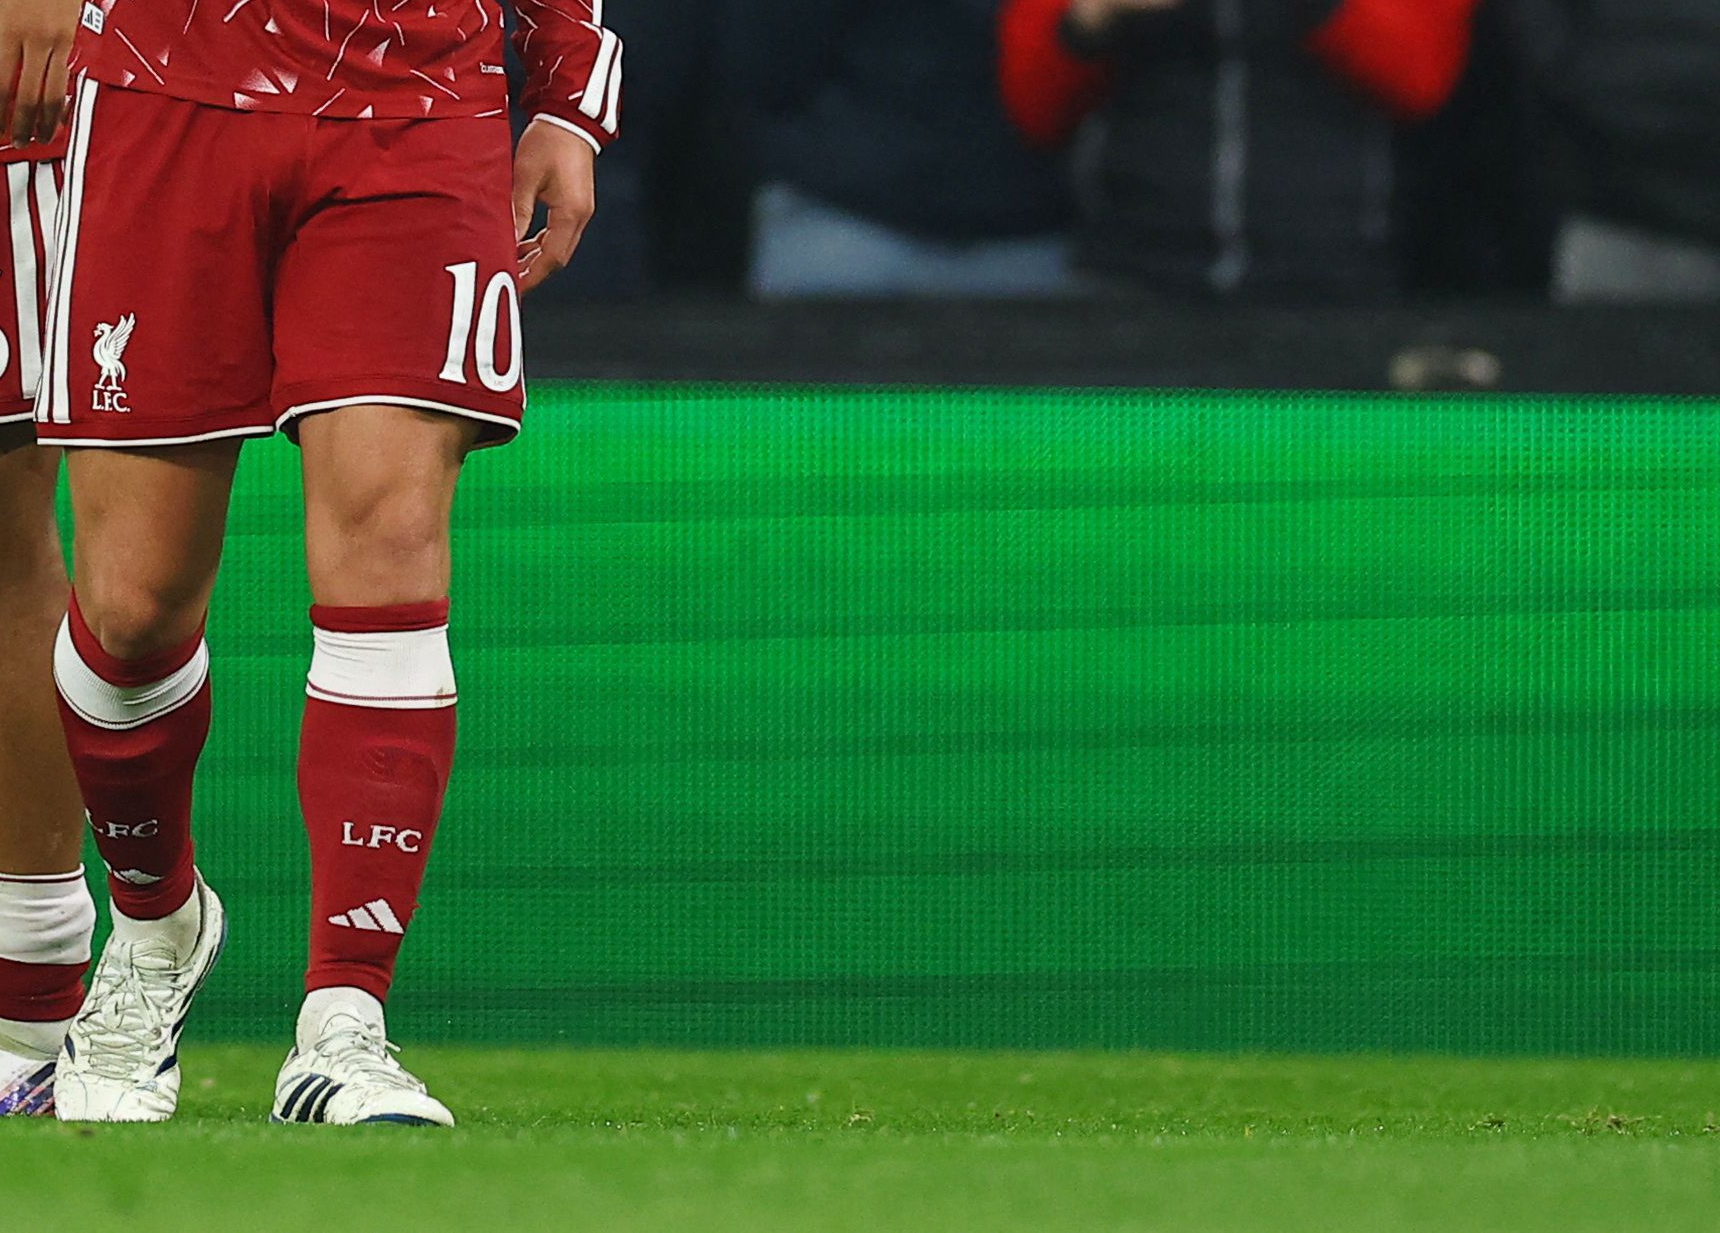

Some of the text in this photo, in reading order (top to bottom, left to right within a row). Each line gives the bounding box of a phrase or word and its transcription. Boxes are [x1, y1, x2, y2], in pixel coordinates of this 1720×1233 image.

[439, 261, 522, 392] 10
[92, 391, 130, 412] L.F.C.
[85, 808, 158, 839] LFC
[342, 821, 422, 854] LFC
